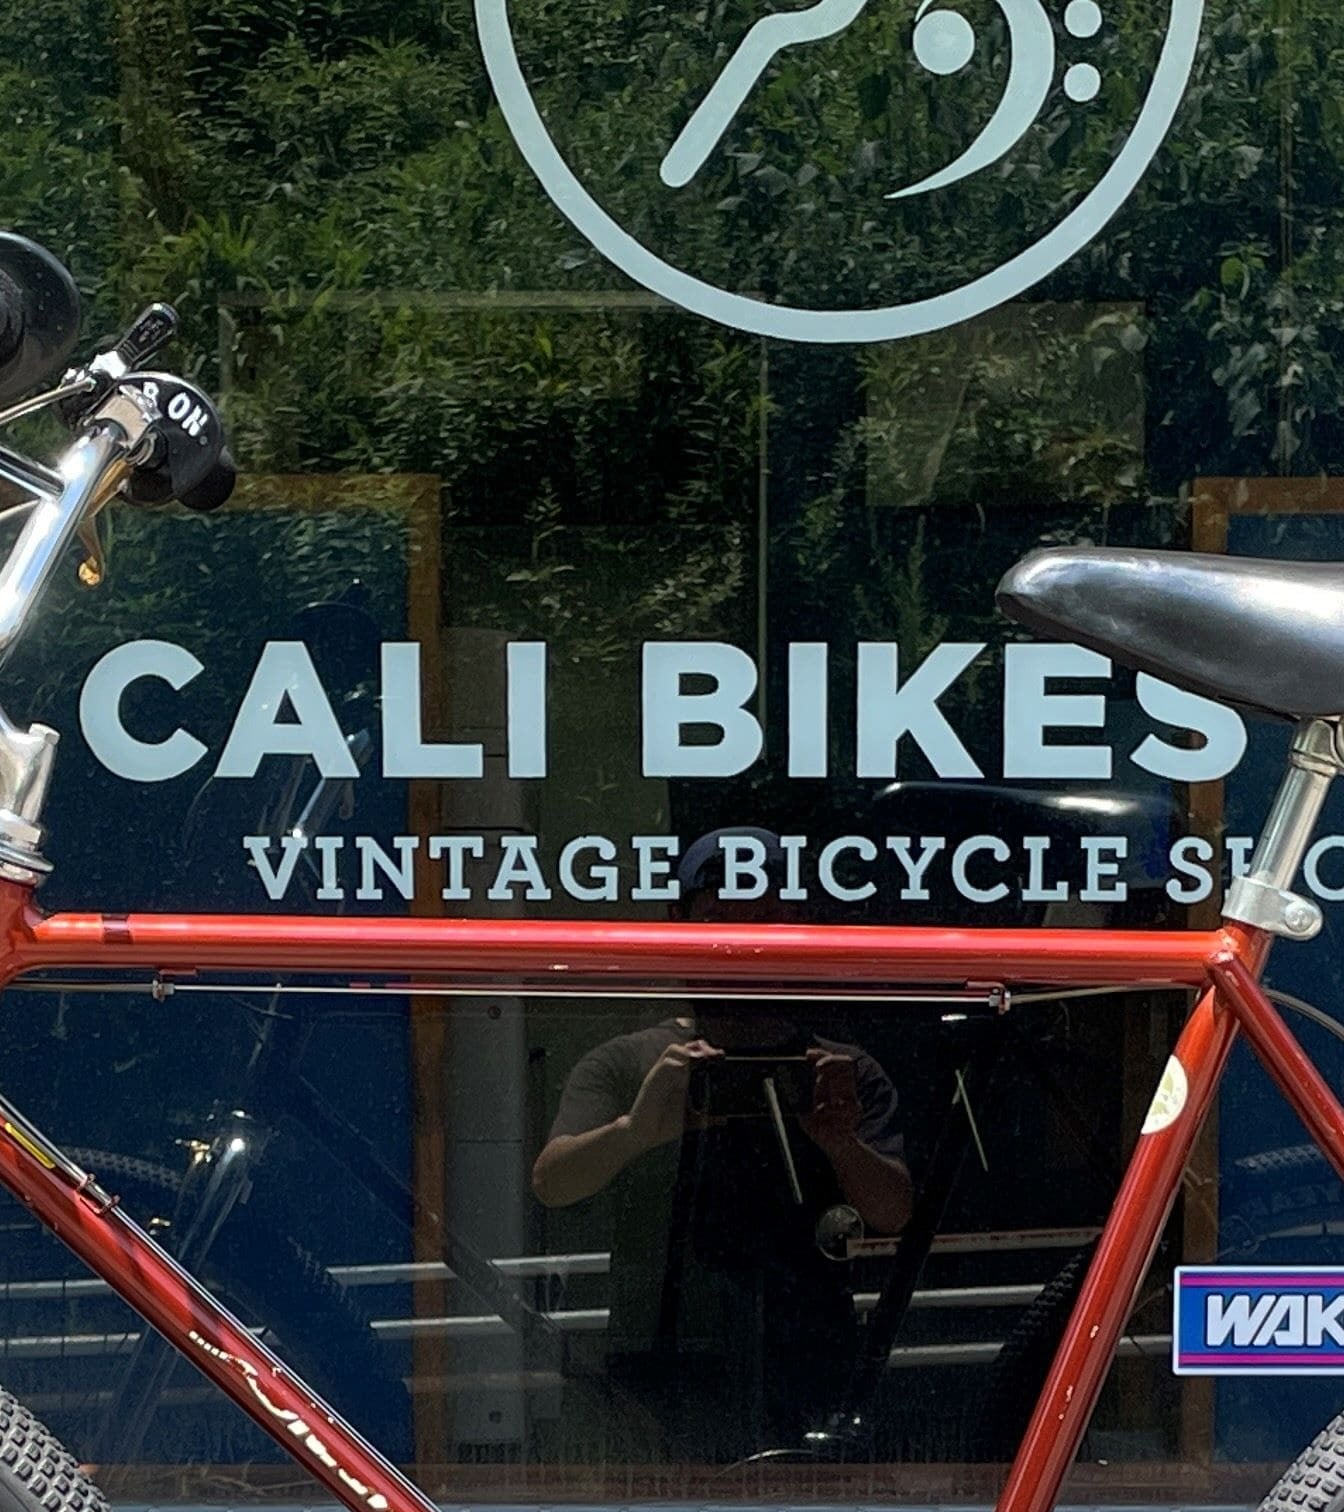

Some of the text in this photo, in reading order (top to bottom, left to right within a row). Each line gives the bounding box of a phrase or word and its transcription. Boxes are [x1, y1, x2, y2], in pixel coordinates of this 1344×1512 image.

[79, 639, 547, 782] CALI
[641, 641, 1248, 782] BIKES
[243, 835, 681, 901] VINTAGE
[717, 834, 1128, 902] BICYCLE
